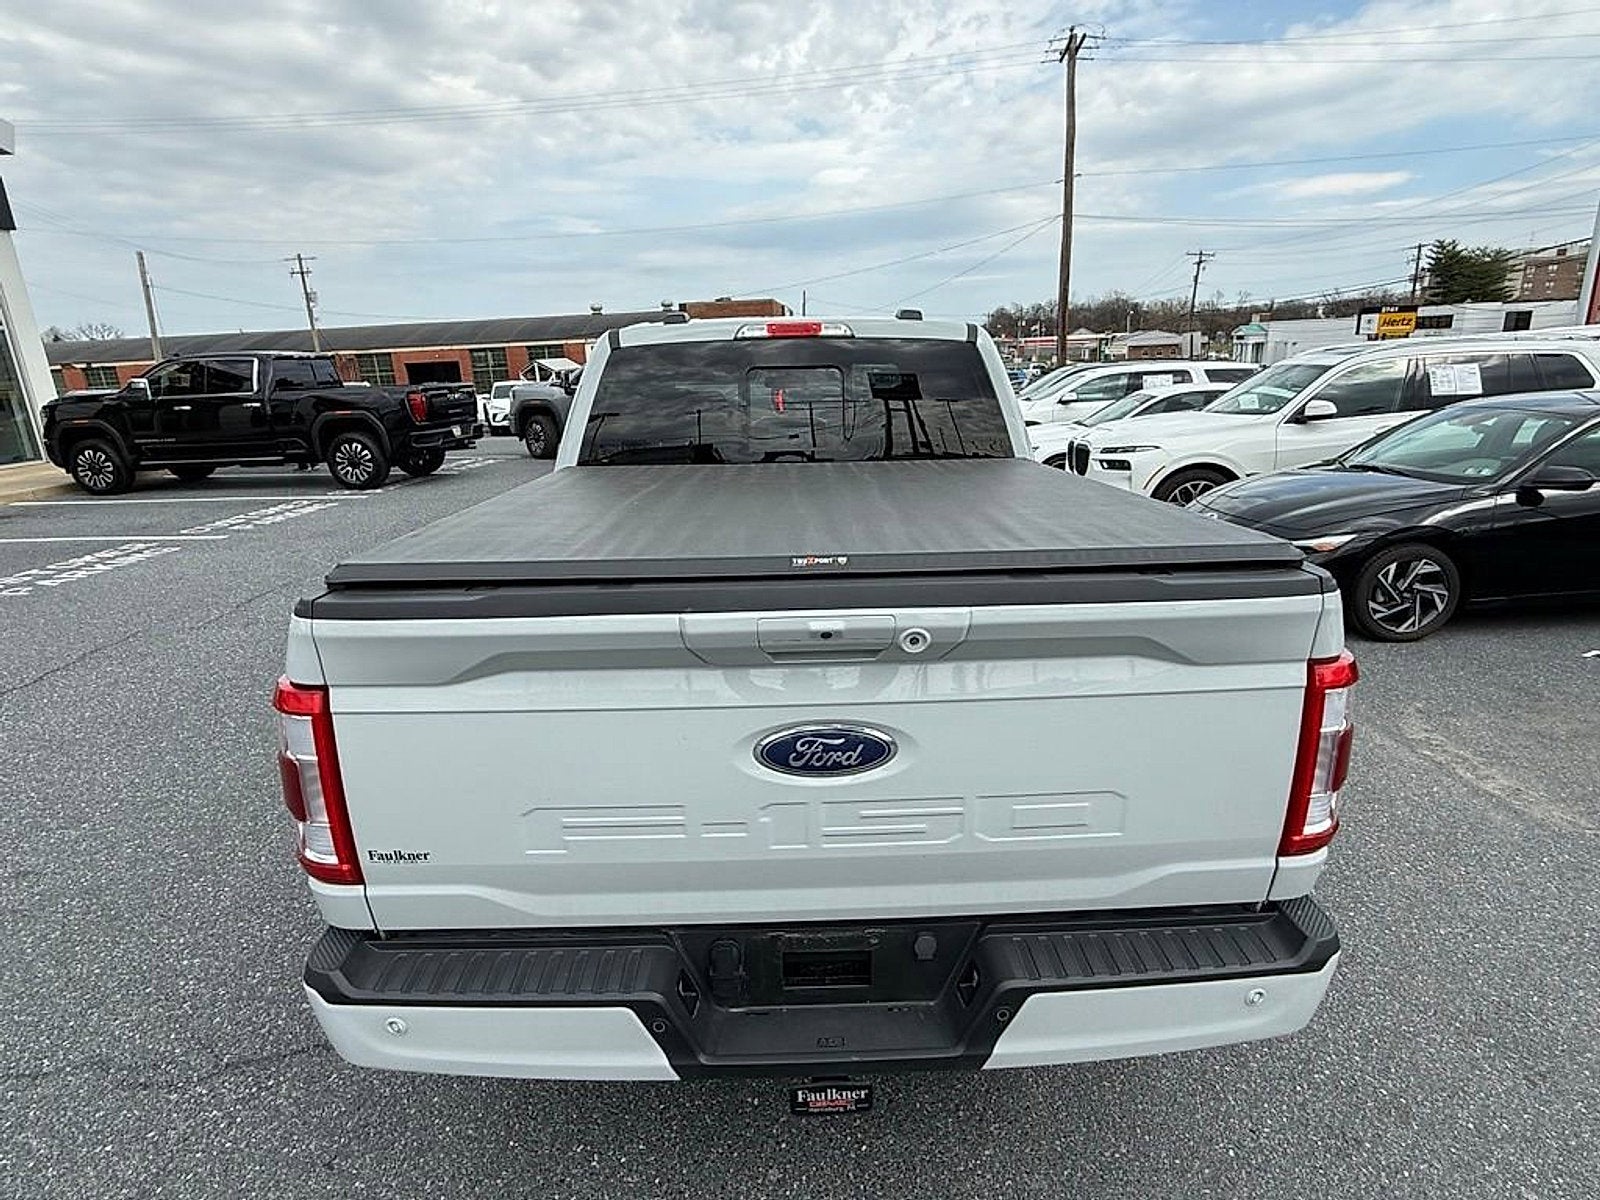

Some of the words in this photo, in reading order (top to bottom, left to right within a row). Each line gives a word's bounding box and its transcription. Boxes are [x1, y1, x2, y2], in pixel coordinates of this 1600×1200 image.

[1381, 316, 1413, 328] Hertz
[788, 737, 864, 767] Ford
[521, 790, 1128, 854] F-150
[368, 849, 430, 861] Faulkner
[796, 1088, 868, 1102] Faulkner
